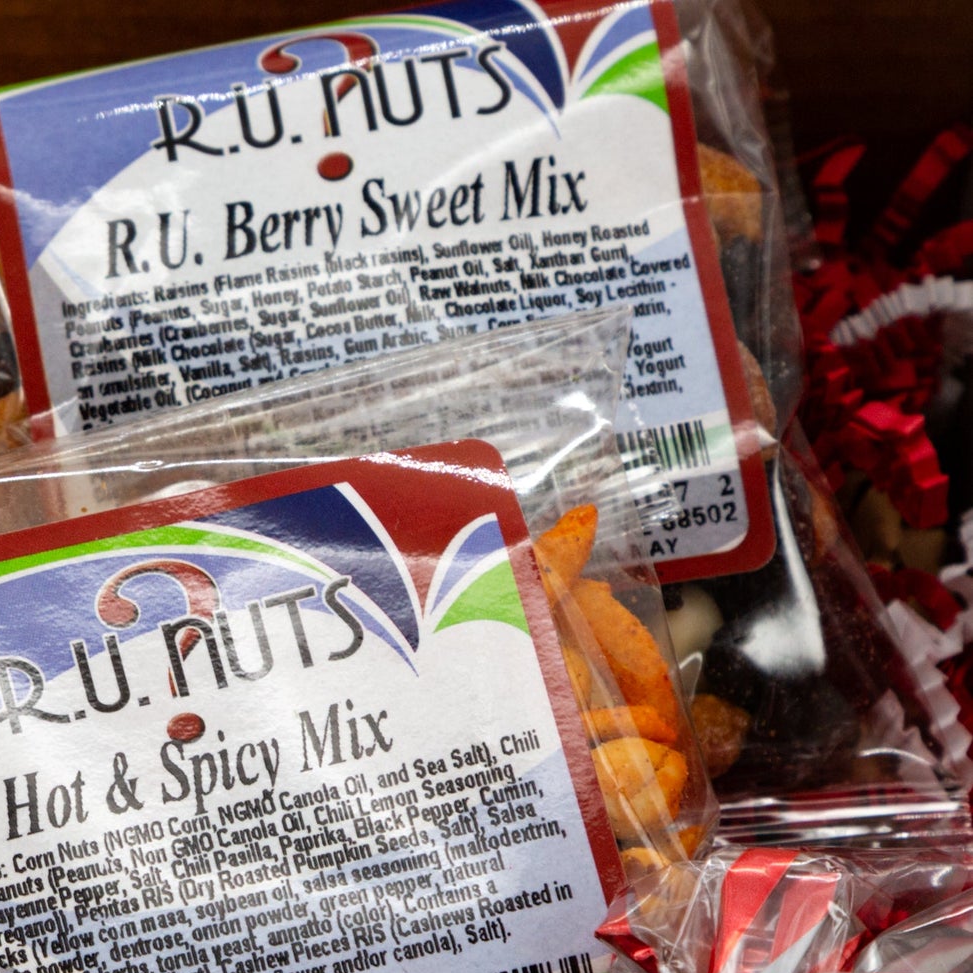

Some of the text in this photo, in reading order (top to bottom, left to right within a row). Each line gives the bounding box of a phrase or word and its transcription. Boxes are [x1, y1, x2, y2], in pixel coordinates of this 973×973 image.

[105, 155, 589, 279] R.U. Berry Sweet Mix
[542, 220, 650, 251] Honey Roasted
[3, 699, 394, 841] Hot & Spicy Mix
[13, 850, 56, 874] Corn
[58, 839, 99, 862] Nuts
[104, 821, 163, 852] (NGMO
[168, 814, 217, 838] Corn,
[218, 796, 275, 827] NGMO
[279, 785, 340, 811] Canola
[345, 774, 373, 797] Oil,
[377, 763, 409, 789] and
[413, 758, 447, 779] Sea
[500, 729, 540, 756] Chili
